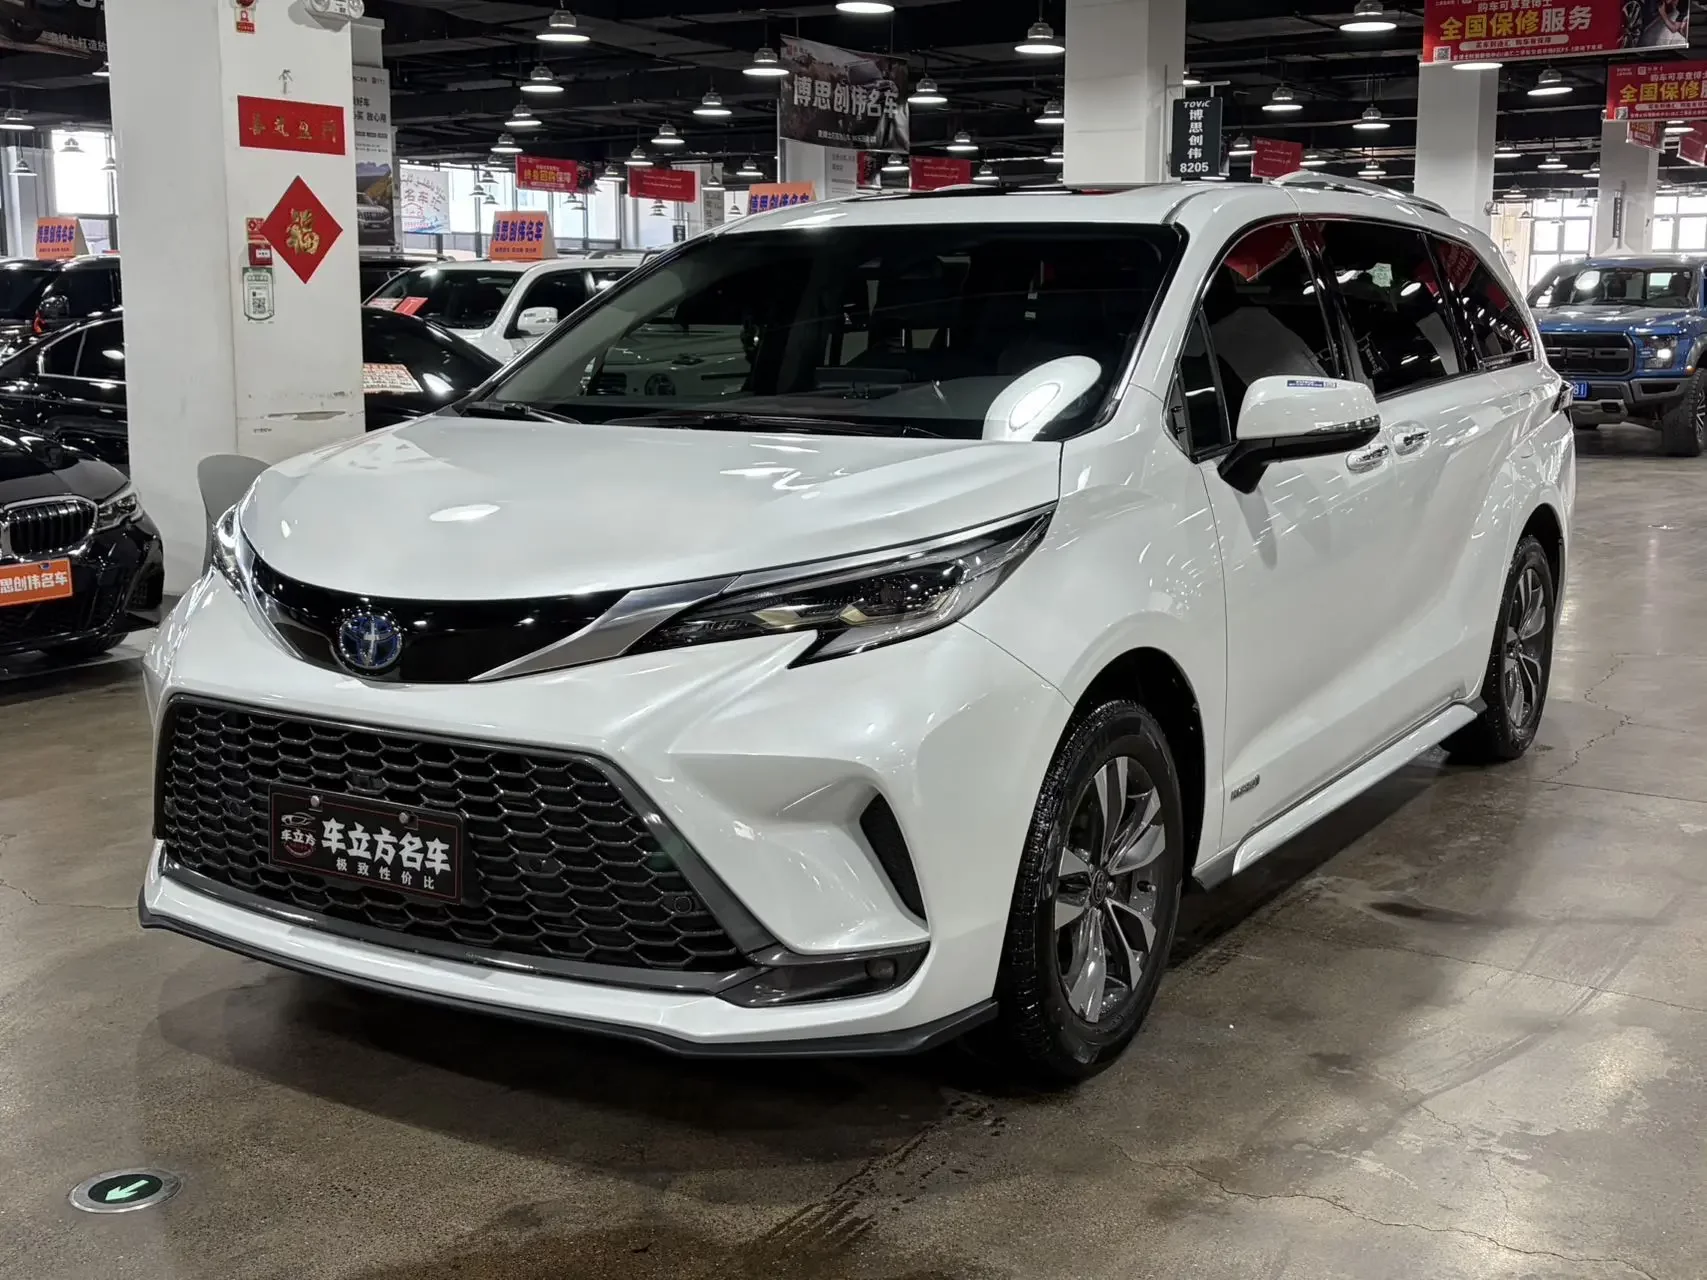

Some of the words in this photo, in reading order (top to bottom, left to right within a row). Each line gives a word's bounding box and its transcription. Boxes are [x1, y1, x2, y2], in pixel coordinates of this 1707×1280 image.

[1440, 6, 1592, 41] 全国保修服务
[794, 74, 898, 120] 博思创伟名车
[1620, 80, 1707, 103] 全国保修
[1187, 109, 1204, 159] 博思创伟
[1180, 162, 1209, 173] 8205
[285, 207, 320, 255] 福
[0, 571, 68, 594] 思创伟名车
[321, 817, 451, 875] 车立方名车
[336, 857, 435, 890] 极致性价比
